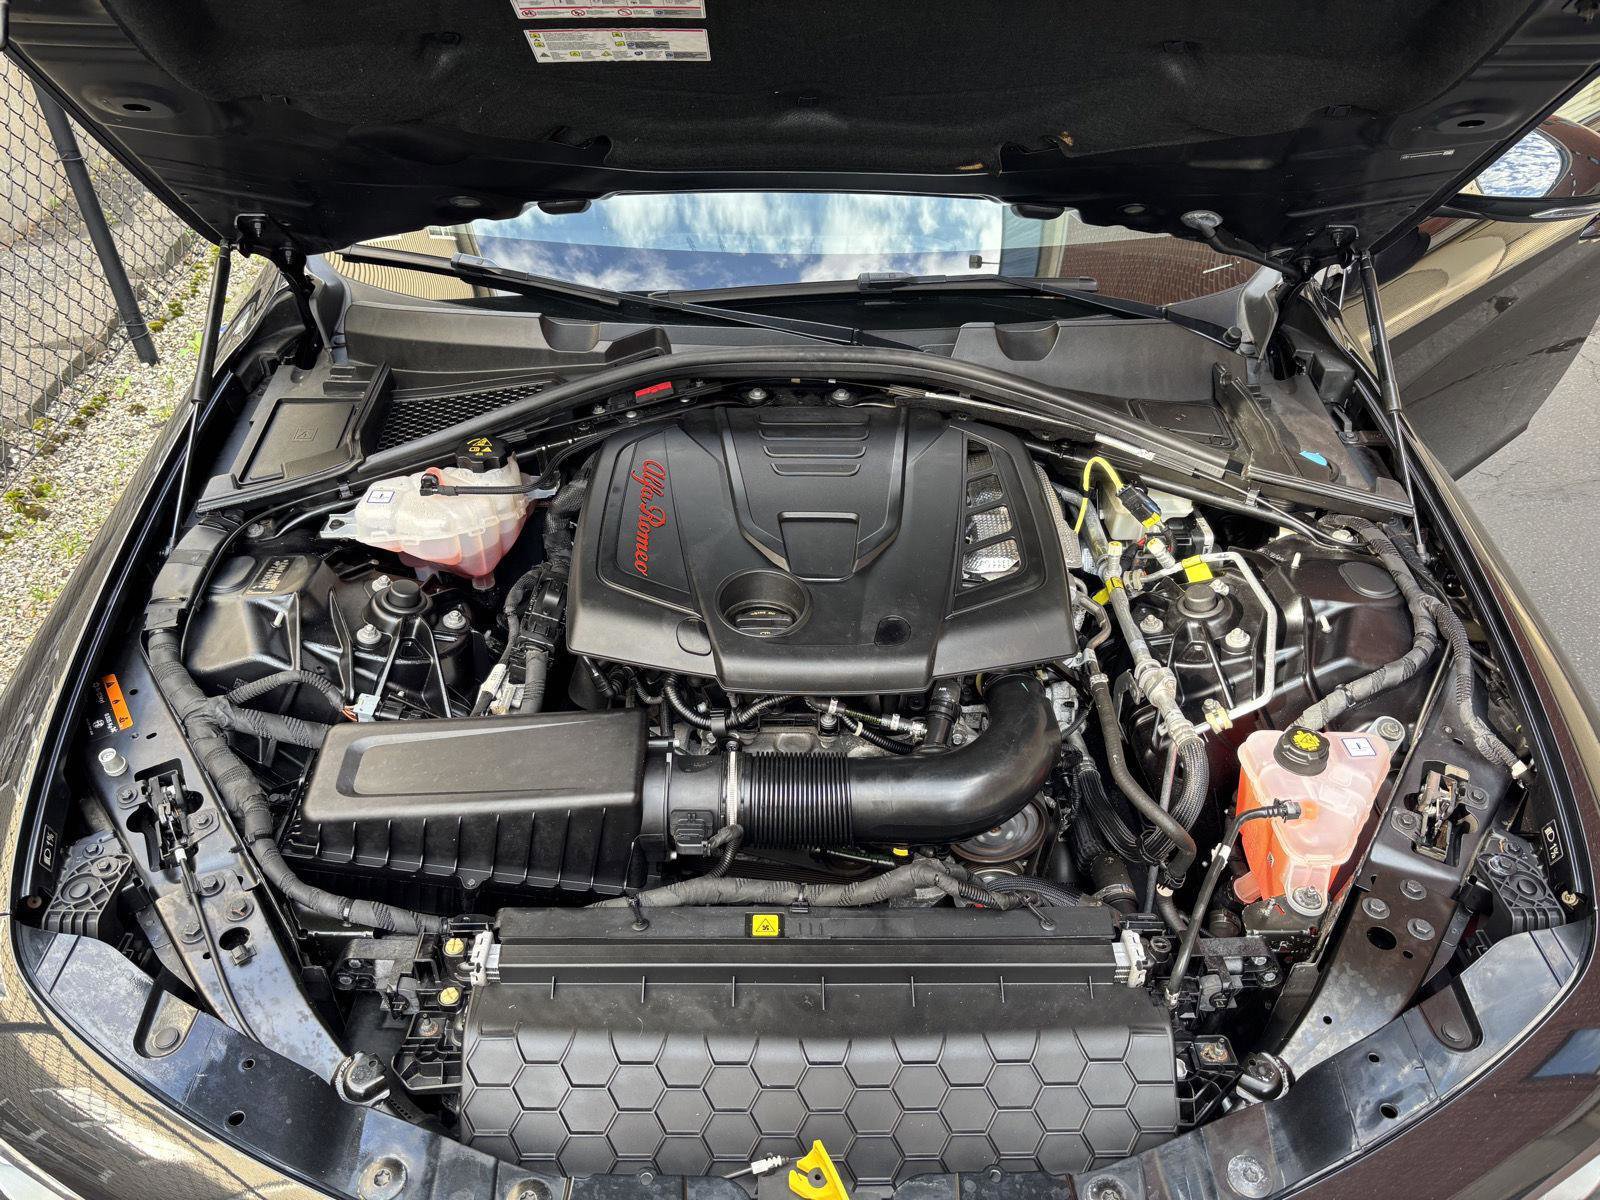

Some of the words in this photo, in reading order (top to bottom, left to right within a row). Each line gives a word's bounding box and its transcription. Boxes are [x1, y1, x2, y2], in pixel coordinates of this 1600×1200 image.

[631, 459, 665, 504] Alfa
[634, 502, 666, 577] Romeo
[46, 831, 55, 847] 1%
[1549, 843, 1559, 860] 1%
